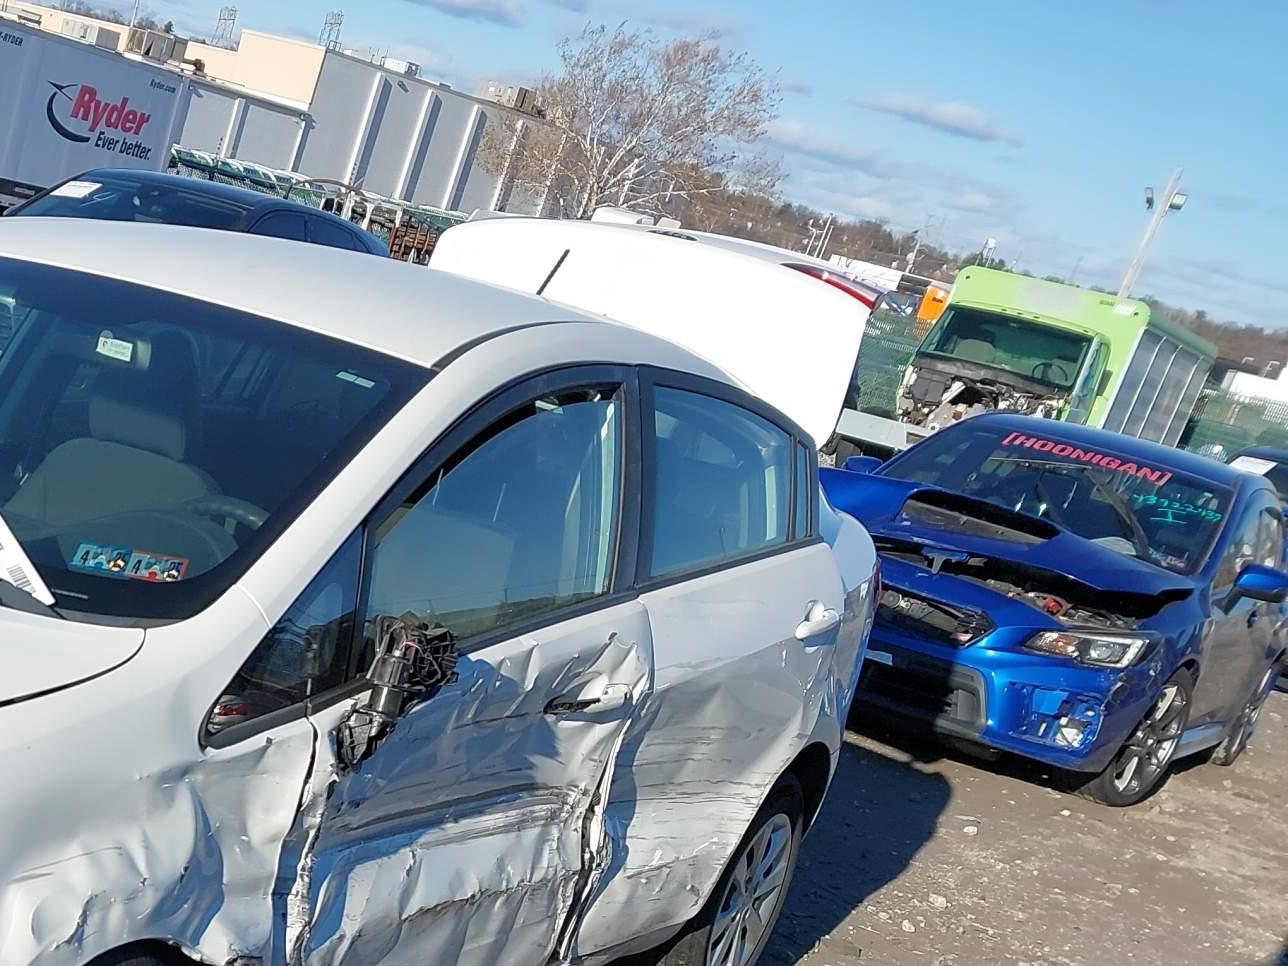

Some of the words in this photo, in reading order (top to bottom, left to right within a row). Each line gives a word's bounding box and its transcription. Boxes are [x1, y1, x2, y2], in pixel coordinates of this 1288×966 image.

[150, 79, 177, 94] Ryder.com
[70, 83, 151, 136] Ryder
[94, 131, 120, 152] Ever
[119, 137, 152, 161] better.
[80, 549, 90, 565] 4
[132, 559, 142, 575] 4
